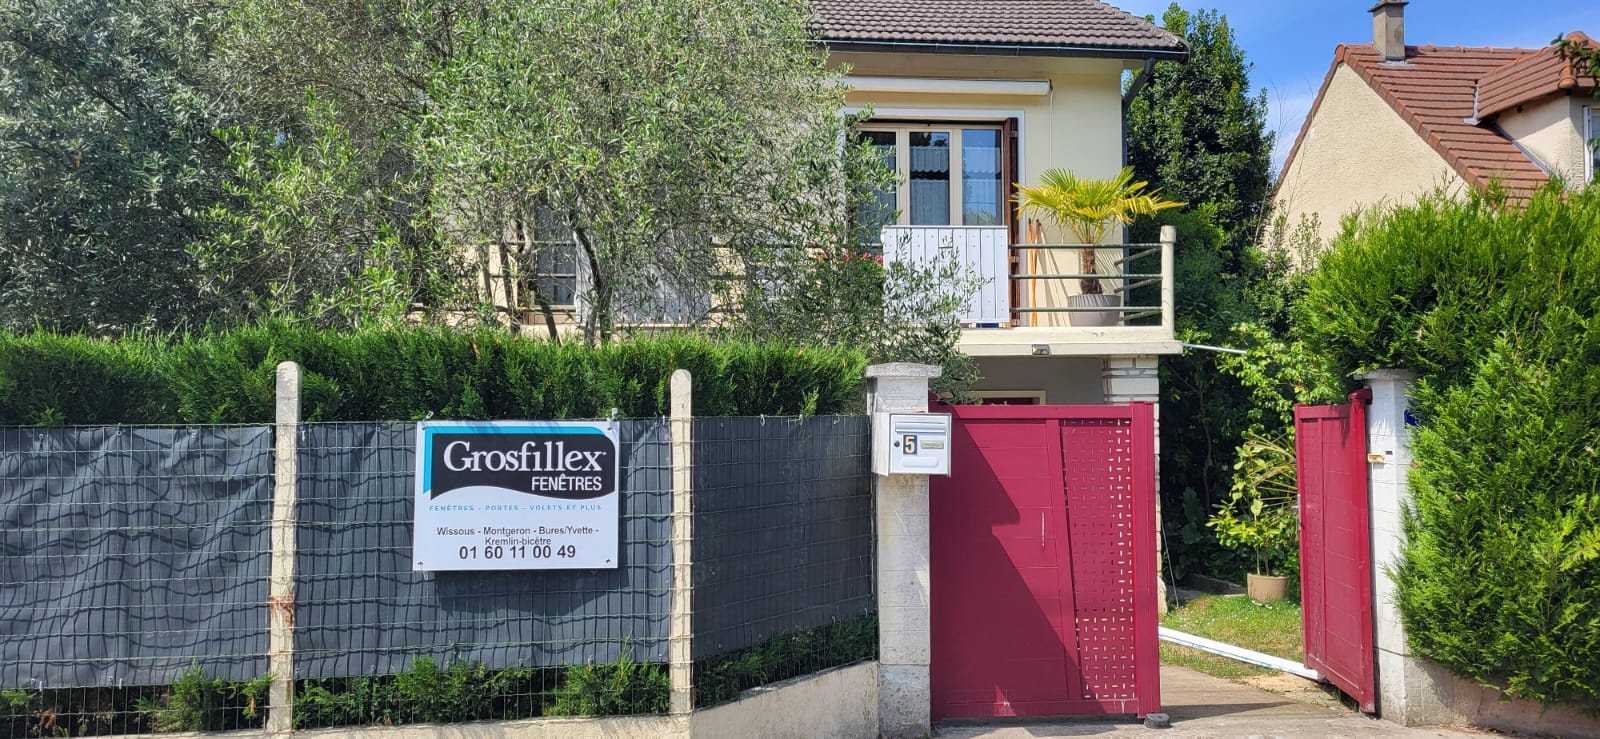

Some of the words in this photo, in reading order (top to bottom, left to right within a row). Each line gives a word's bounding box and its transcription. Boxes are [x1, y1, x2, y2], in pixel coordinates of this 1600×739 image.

[904, 435, 916, 454] 5
[443, 440, 603, 472] Grosfillex
[531, 473, 603, 491] FENÊTRES
[436, 527, 475, 535] Wissous
[483, 526, 531, 537] Montgeron
[538, 526, 593, 535] Bures/Yvette
[485, 537, 552, 545] Kremlin-bicêtre
[459, 545, 477, 559] 01
[484, 545, 503, 559] 60
[509, 545, 526, 559] 11
[532, 545, 552, 558] 00
[557, 545, 576, 558] 49
